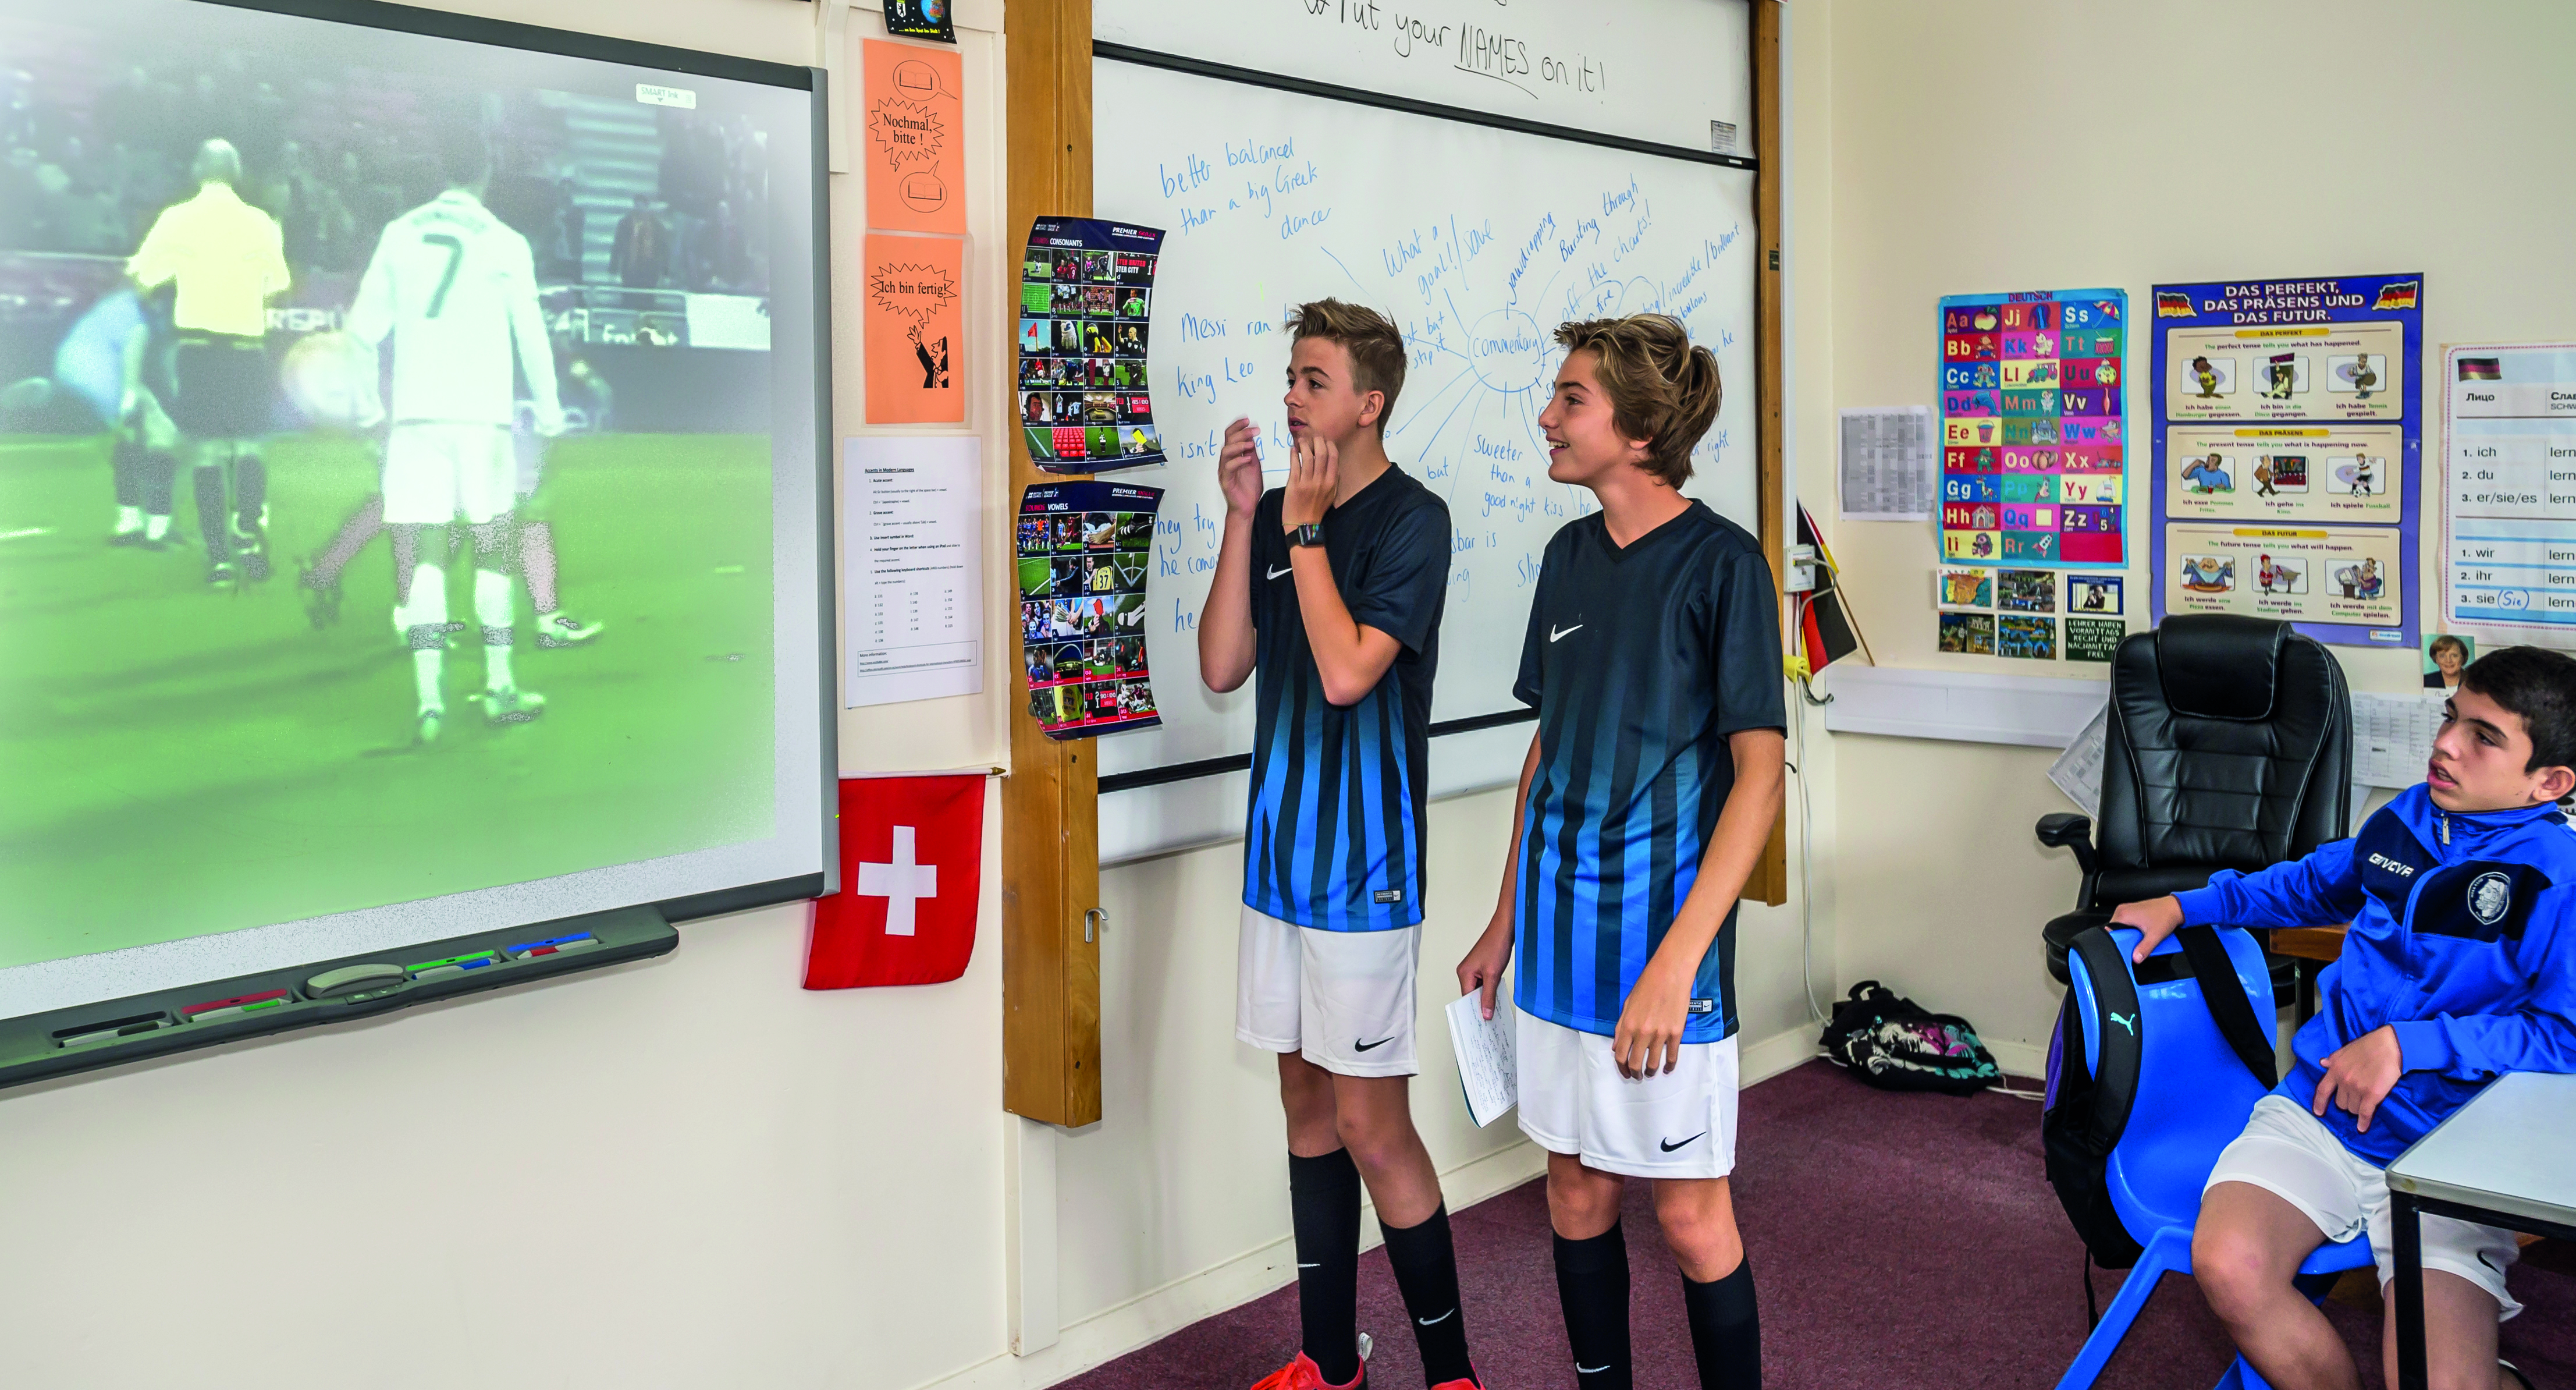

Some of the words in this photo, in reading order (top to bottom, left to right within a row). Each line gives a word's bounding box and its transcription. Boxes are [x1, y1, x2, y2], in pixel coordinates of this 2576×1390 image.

[1394, 13, 1451, 57] your
[1460, 22, 1529, 77] NAMES
[1541, 56, 1569, 86] on
[1577, 52, 1605, 105] it!
[883, 113, 932, 133] Nochmal,
[893, 129, 916, 144] bitte
[921, 133, 923, 146] !
[1160, 154, 1211, 198] better
[1229, 198, 1241, 210] a
[1248, 182, 1271, 219] big
[1559, 218, 1600, 263] Bursting
[1603, 172, 1639, 217] through
[1113, 227, 1137, 235] PREMIER
[1613, 198, 1652, 263] charts!
[1050, 237, 1082, 247] CONSONANTS
[1383, 228, 1421, 277] What
[1432, 225, 1438, 240] a
[1503, 212, 1557, 306] jawdropping
[881, 281, 896, 293] Ich
[899, 281, 914, 294] bin
[918, 282, 947, 297] fertig!
[2226, 285, 2259, 297] DAS
[2265, 282, 2339, 295] PERFEKT,
[2204, 300, 2238, 311] DAS
[2243, 295, 2319, 309] PRÄSENS
[2326, 295, 2364, 306] UND
[2233, 312, 2267, 323] DAS
[2273, 310, 2331, 322] FUTUR.
[1181, 313, 1227, 343] Messi
[1247, 321, 1271, 335] ran
[1948, 340, 1971, 356] Bb
[2324, 339, 2361, 347] happened.
[1225, 357, 1254, 383] Leo
[2466, 393, 2495, 402] Лицо
[2478, 446, 2496, 457] ich
[1427, 456, 1449, 480] but
[1490, 463, 1515, 484] than
[2477, 469, 2493, 480] du
[1482, 491, 1506, 517] good
[1544, 497, 1564, 517] kiss
[2477, 492, 2537, 505] er/sie/es
[1193, 503, 1216, 549] try
[1159, 544, 1180, 577] he
[2476, 548, 2495, 558] wir
[1100, 575, 1108, 588] 37
[2476, 570, 2493, 581] ihr
[2476, 593, 2495, 604] sie
